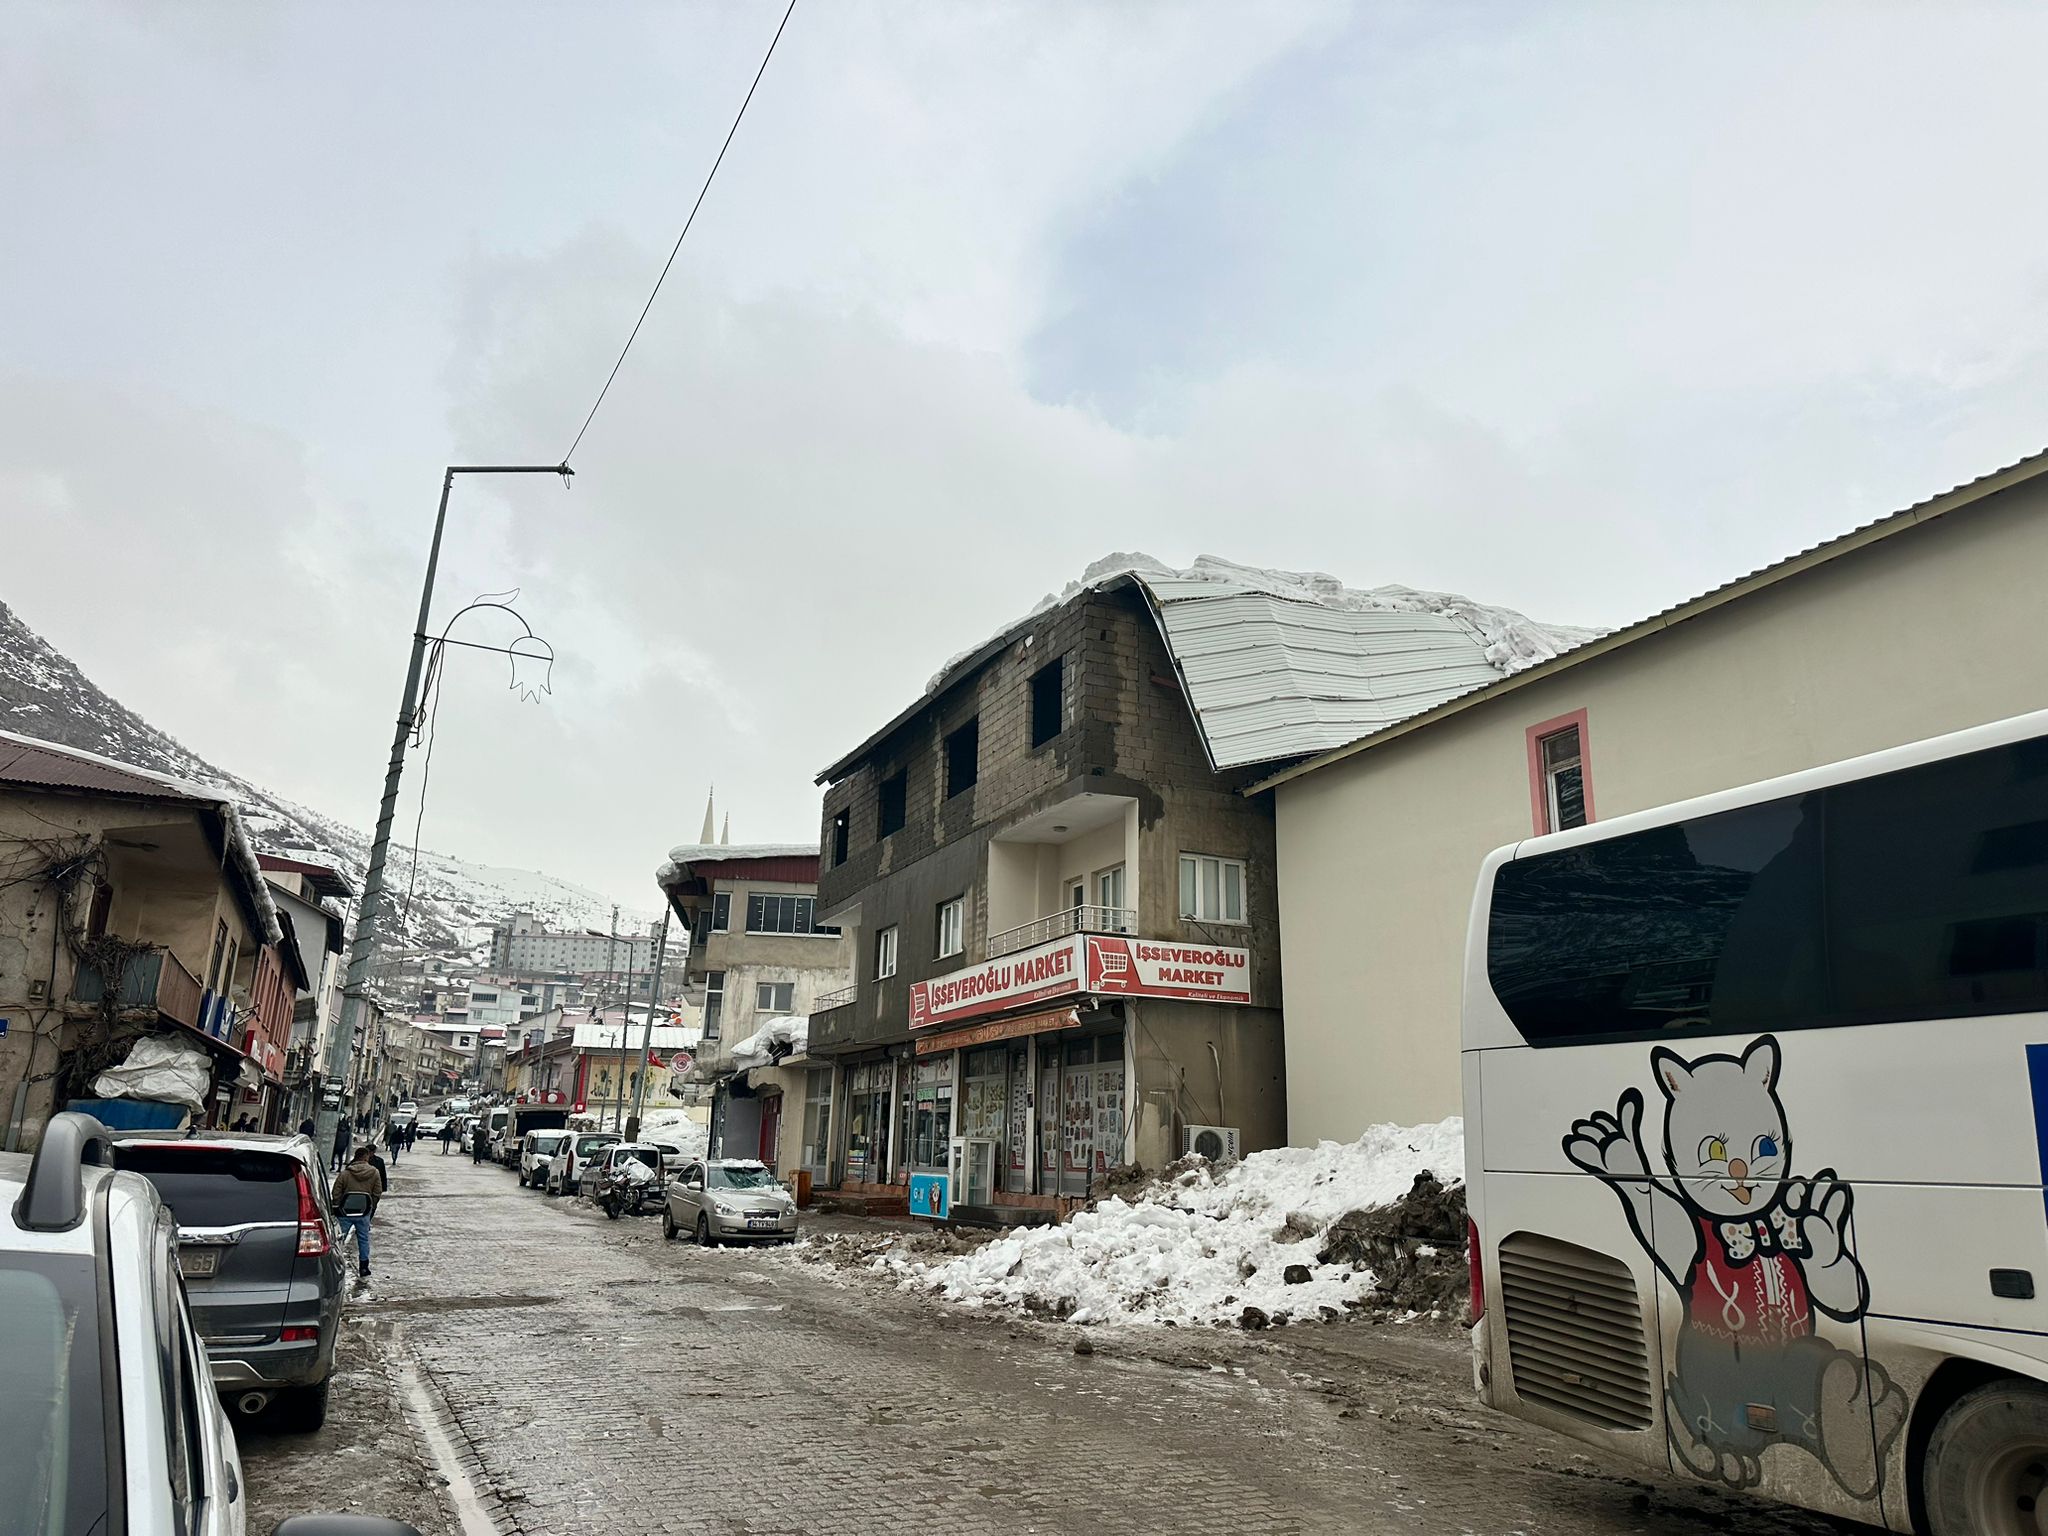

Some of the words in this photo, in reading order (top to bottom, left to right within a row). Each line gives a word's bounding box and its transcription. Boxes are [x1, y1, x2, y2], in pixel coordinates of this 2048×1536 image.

[1136, 943, 1245, 968] İŞSEVEROĞLU
[931, 965, 1011, 1010] İŞSEVEROĞLU
[1014, 946, 1074, 987] MARKET
[1158, 967, 1225, 986] MARKET
